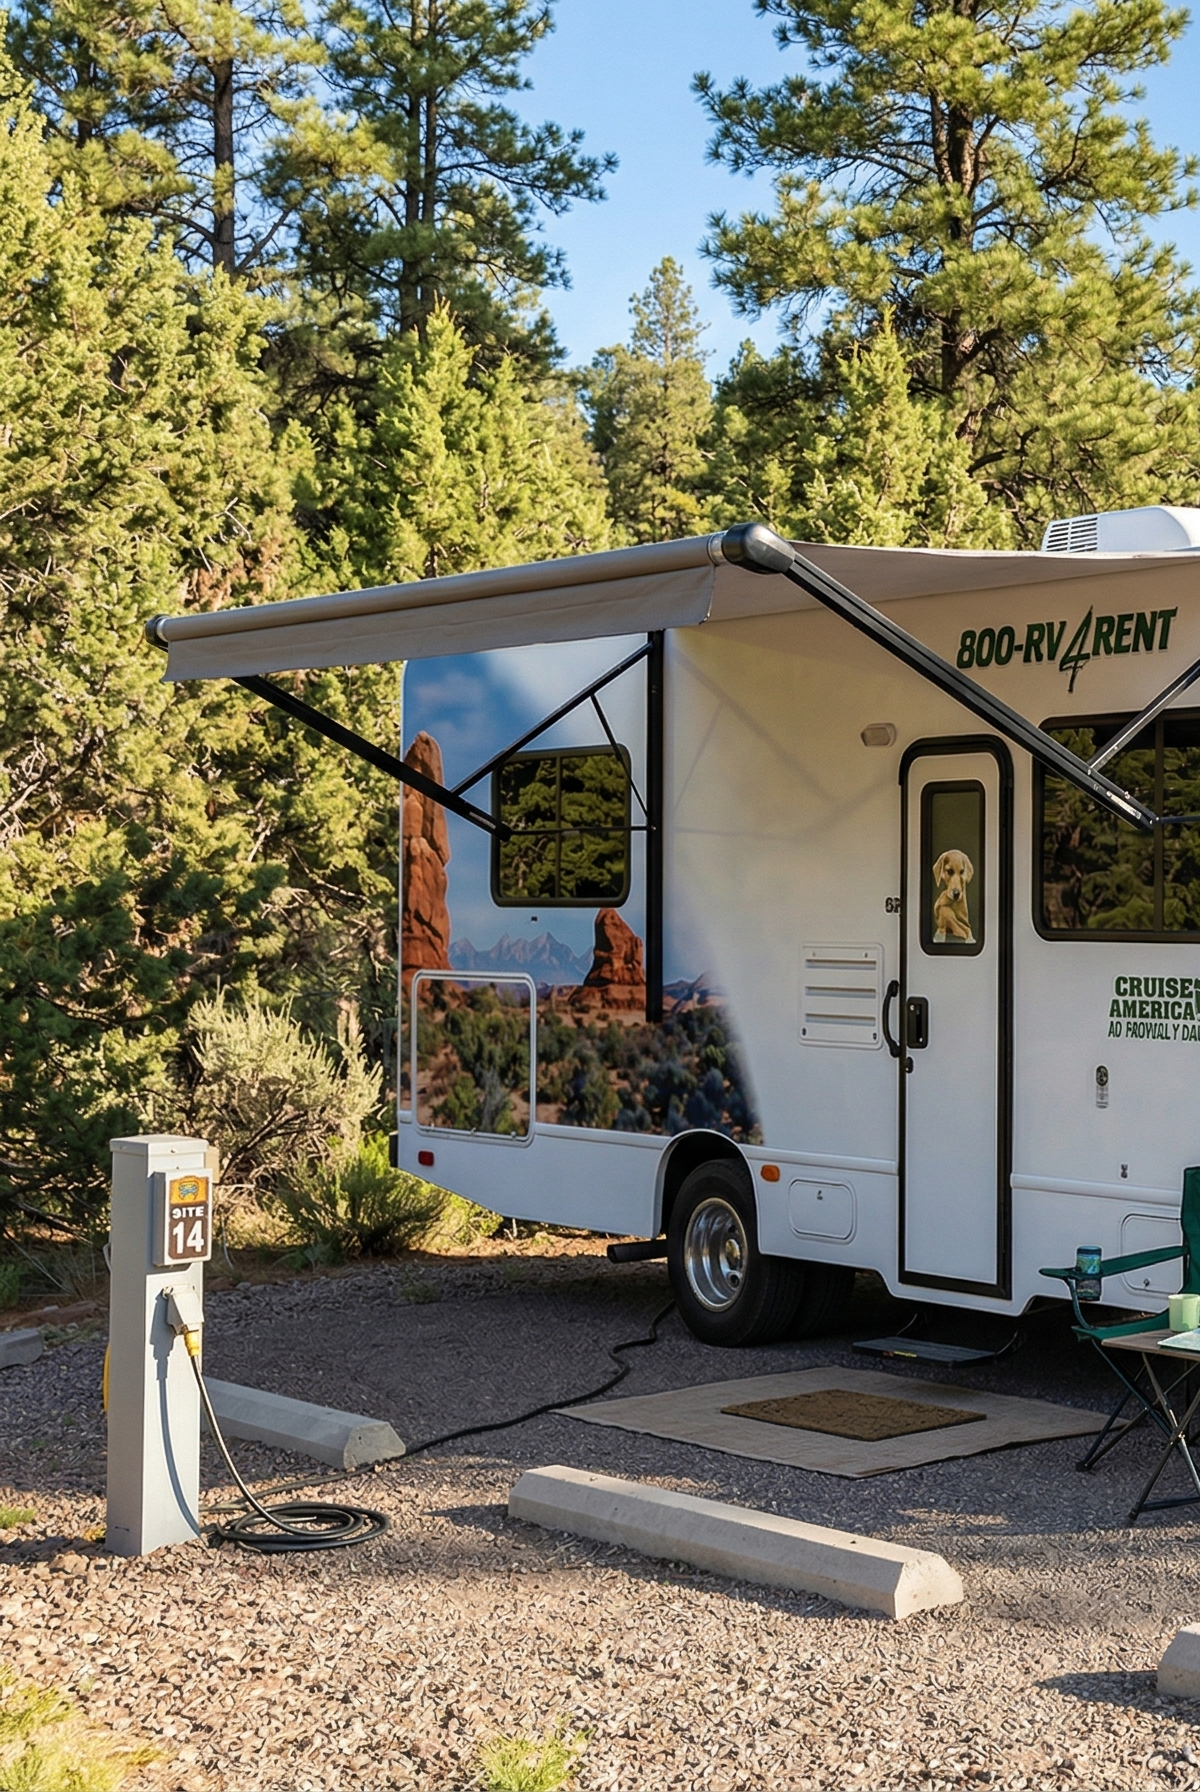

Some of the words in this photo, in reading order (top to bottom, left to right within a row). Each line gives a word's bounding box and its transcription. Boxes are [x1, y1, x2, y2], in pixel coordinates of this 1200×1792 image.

[1115, 975, 1193, 998] CRUISE
[1109, 999, 1195, 1021] AMERICA
[172, 1220, 204, 1254] 14
